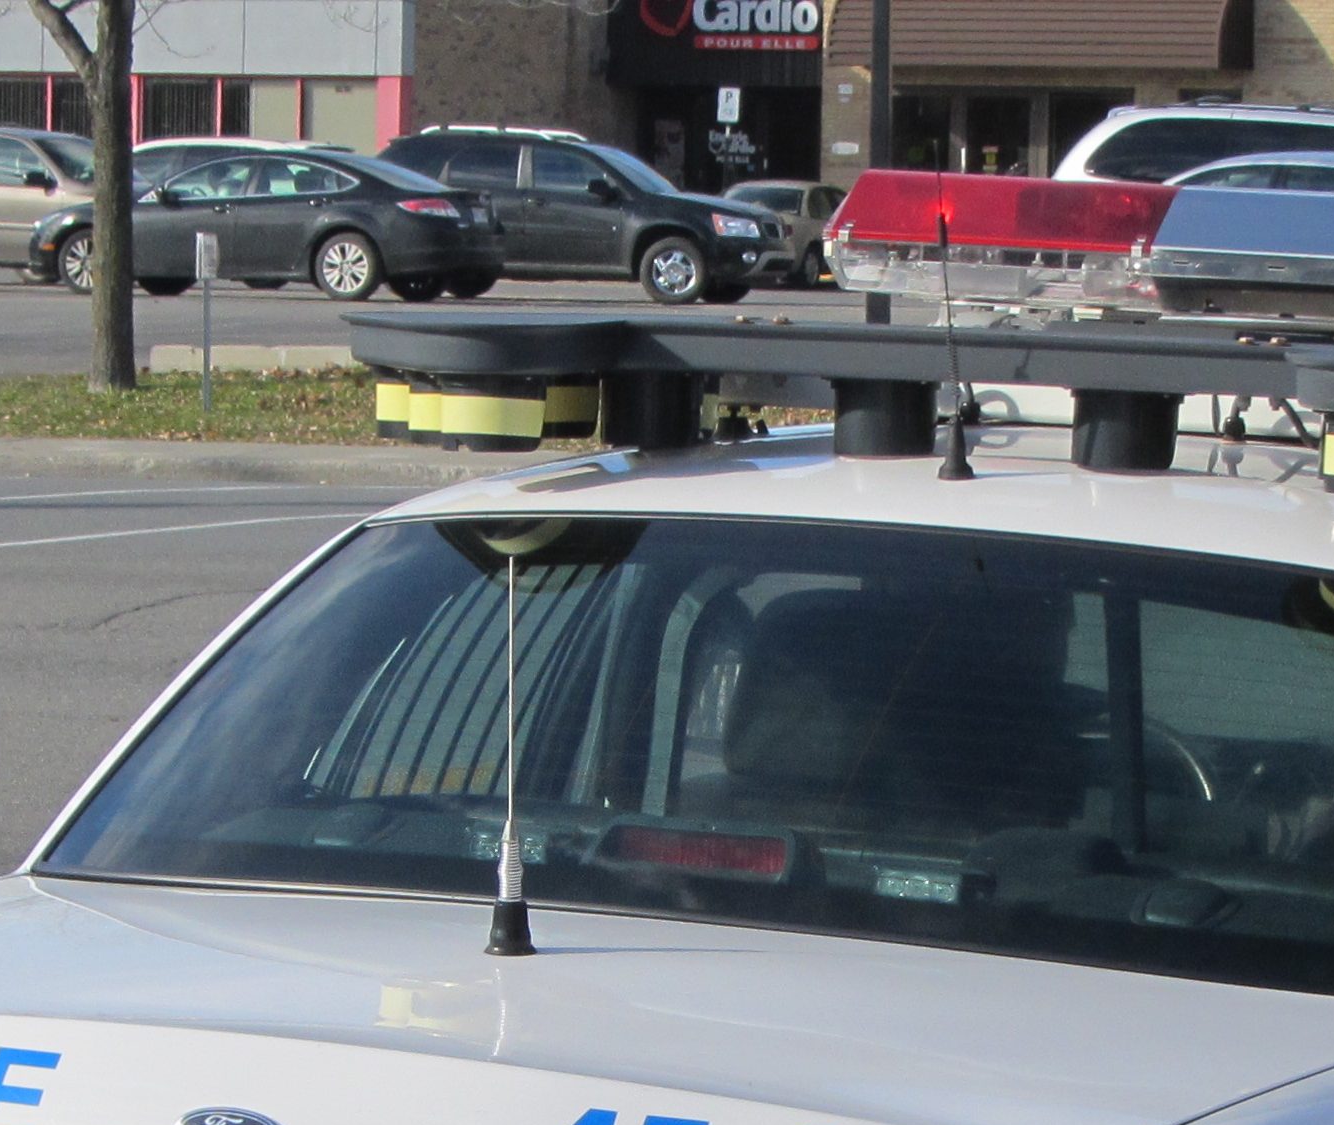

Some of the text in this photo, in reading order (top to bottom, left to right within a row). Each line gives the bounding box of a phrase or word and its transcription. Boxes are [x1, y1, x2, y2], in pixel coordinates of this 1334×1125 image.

[692, 0, 818, 33] Cardio
[703, 38, 806, 49] POUR ELLE
